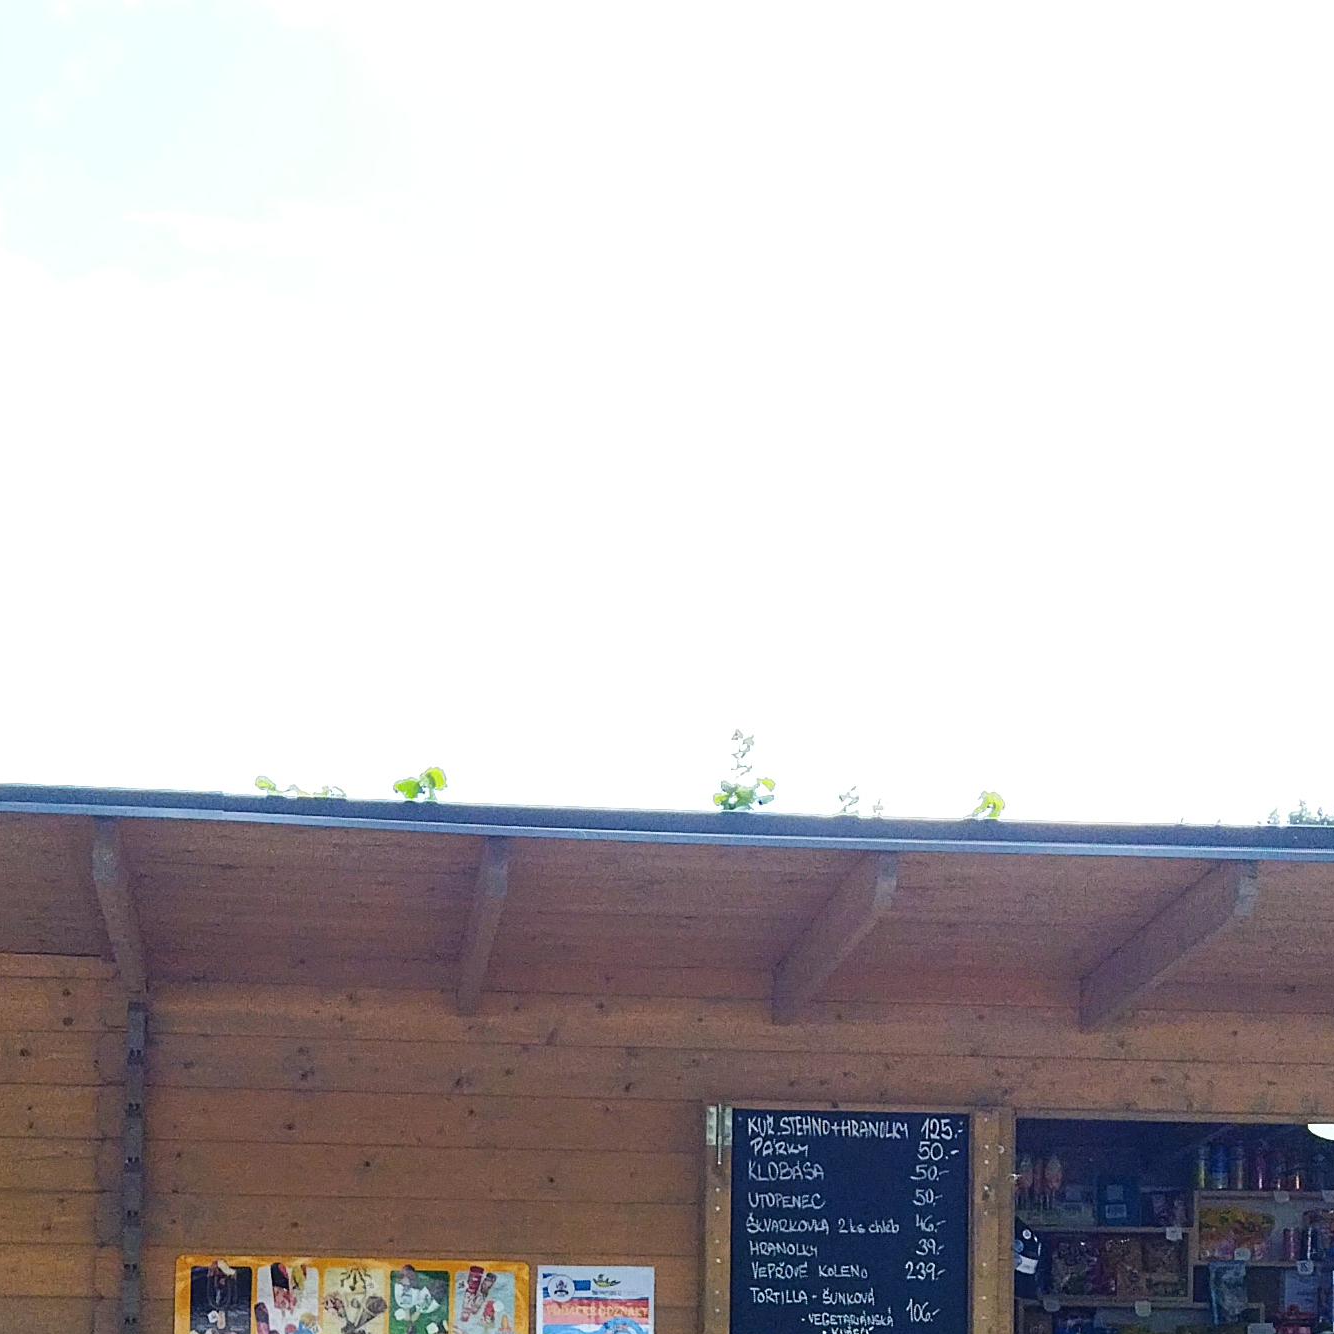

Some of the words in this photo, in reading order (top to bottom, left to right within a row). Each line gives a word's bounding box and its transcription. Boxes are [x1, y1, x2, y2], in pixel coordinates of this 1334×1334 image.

[750, 1137, 809, 1157] PÁRKY
[748, 1160, 824, 1181] KLOBÁSA
[748, 1193, 826, 1209] UTOPENEC
[746, 1212, 830, 1235] ŠKVARKOVKA
[749, 1240, 818, 1257] HRANOLKY
[749, 1287, 808, 1304] TORTILLA
[822, 1288, 875, 1306] ŠUNKOVÁ
